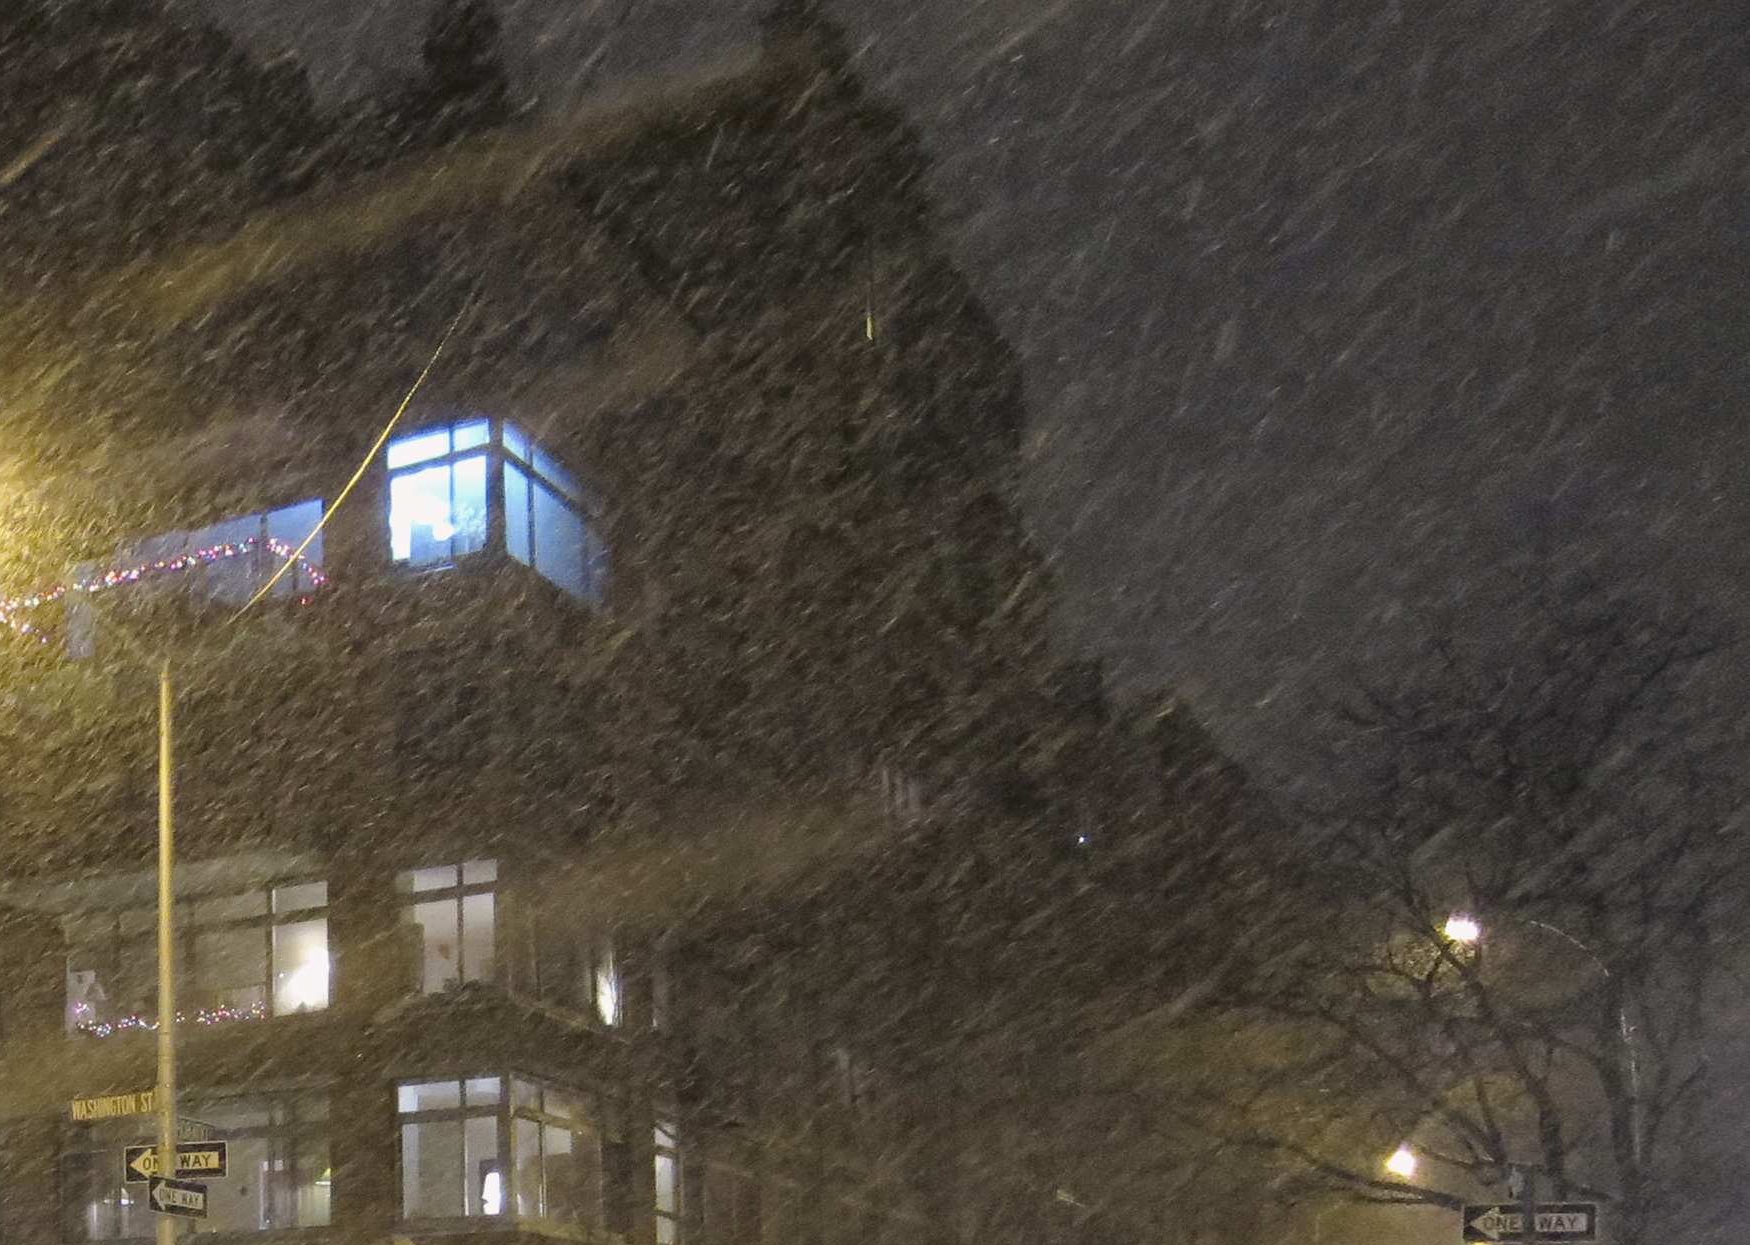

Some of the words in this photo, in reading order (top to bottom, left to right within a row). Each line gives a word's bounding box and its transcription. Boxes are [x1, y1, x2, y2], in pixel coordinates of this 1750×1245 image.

[73, 1095, 136, 1120] WASHINGTON
[141, 1092, 153, 1112] ST
[180, 1154, 210, 1168] WAY
[1483, 1216, 1520, 1231] ONE
[1538, 1216, 1577, 1230] WAY
